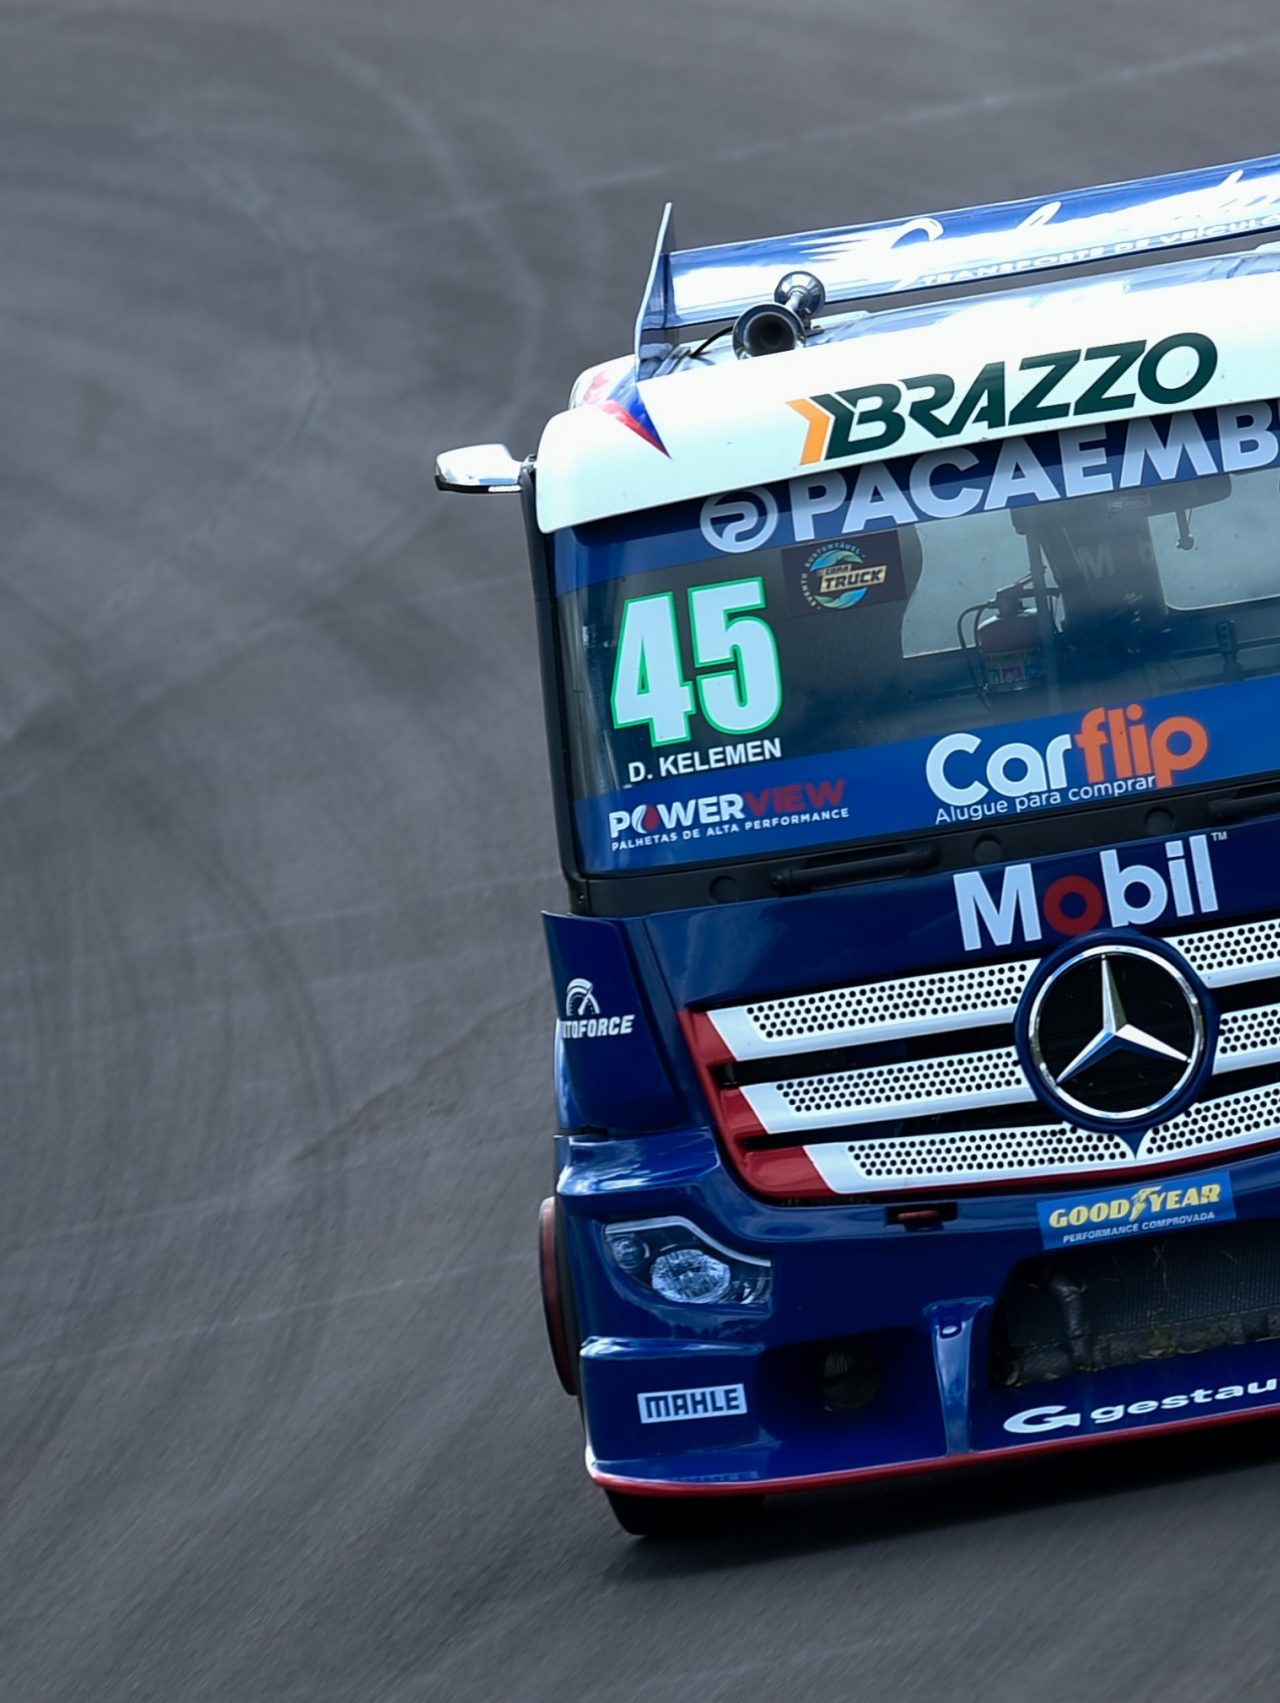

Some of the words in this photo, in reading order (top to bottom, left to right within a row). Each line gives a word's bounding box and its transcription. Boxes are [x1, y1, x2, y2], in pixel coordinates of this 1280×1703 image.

[824, 332, 1218, 460] BRAZZO
[823, 568, 883, 590] TRUCK
[611, 576, 783, 748] 45
[628, 762, 653, 783] D.
[659, 738, 782, 777] KELEMEN
[926, 703, 1210, 807] Carflip
[935, 797, 1009, 825] Alugue
[1015, 790, 1061, 812] para
[1068, 775, 1156, 802] comprar
[611, 832, 678, 852] PALHETAS
[682, 828, 700, 840] DE
[706, 823, 740, 836] ALTA
[745, 807, 850, 830] PERFORMANCE
[953, 834, 1219, 951] Mobil
[1063, 1222, 1139, 1244] PERFORMANCE
[1142, 1211, 1216, 1231] COMPROVADA
[644, 1387, 741, 1419] MAHLE
